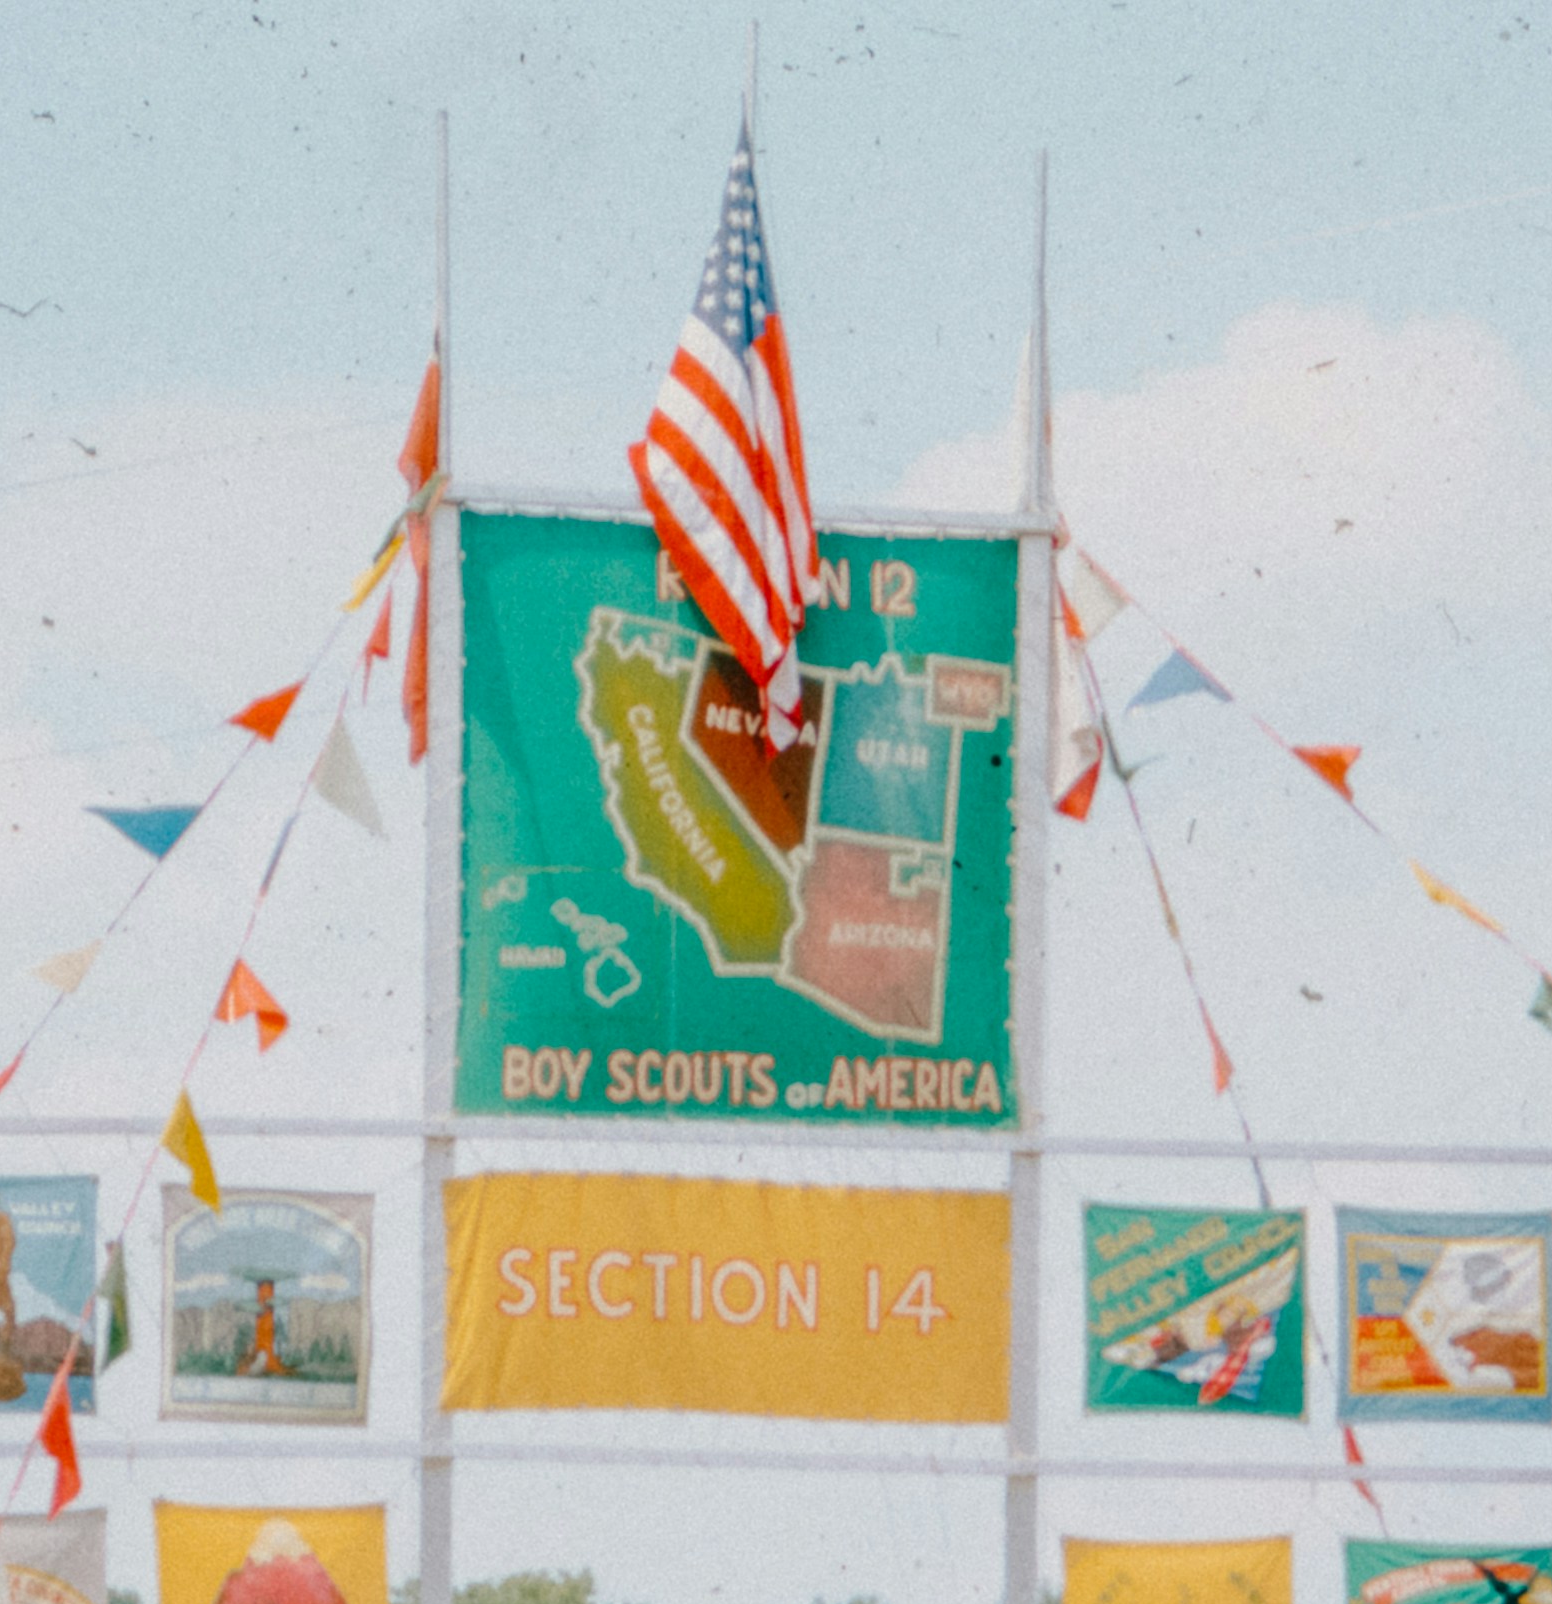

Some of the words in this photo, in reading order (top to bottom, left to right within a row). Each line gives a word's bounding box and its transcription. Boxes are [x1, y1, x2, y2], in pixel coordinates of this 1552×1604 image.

[870, 559, 916, 617] 12
[705, 703, 818, 749] NEVA
[856, 739, 929, 773] UTAH
[626, 703, 728, 886] CALIFORNIA
[828, 923, 935, 951] ARIZONA
[502, 1046, 592, 1101] BOY
[606, 1050, 777, 1106] SCOUTS
[823, 1056, 1001, 1112] AMERICA
[499, 1248, 819, 1331] SECTION
[866, 1266, 947, 1336] 14
